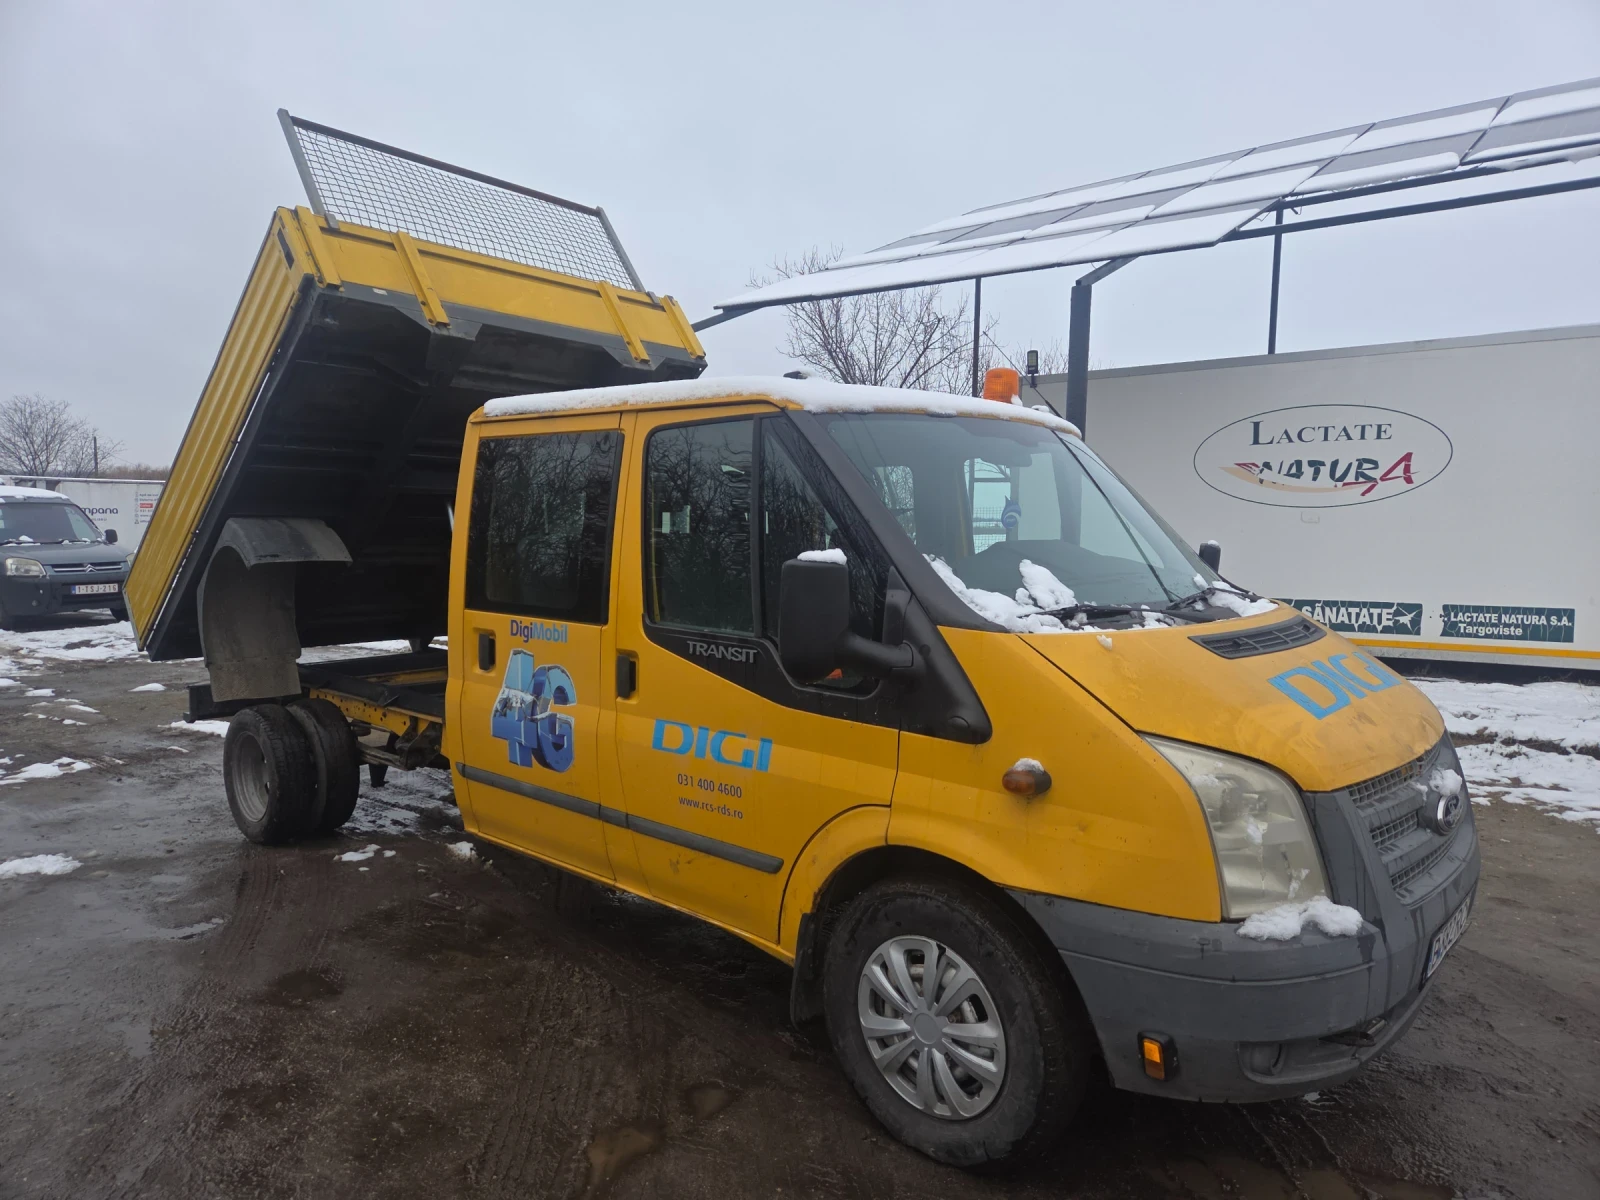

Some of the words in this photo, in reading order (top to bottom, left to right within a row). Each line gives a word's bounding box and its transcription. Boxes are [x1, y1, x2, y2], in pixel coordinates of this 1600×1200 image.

[1250, 420, 1393, 446] LACTATE
[510, 619, 568, 643] DigiMobil
[1450, 611, 1499, 624] LACTATE
[1501, 614, 1547, 625] NATURA
[1550, 615, 1572, 626] S.A.
[1459, 623, 1523, 636] Targoviste
[687, 640, 757, 663] TRANSIT
[1266, 651, 1402, 720] DIGI
[490, 648, 577, 773] 4G
[652, 718, 773, 773] DIGI
[677, 773, 694, 787] 031
[697, 778, 715, 792] 400
[718, 782, 742, 799] 4600
[679, 796, 743, 820] www.rcs-rds.ro
